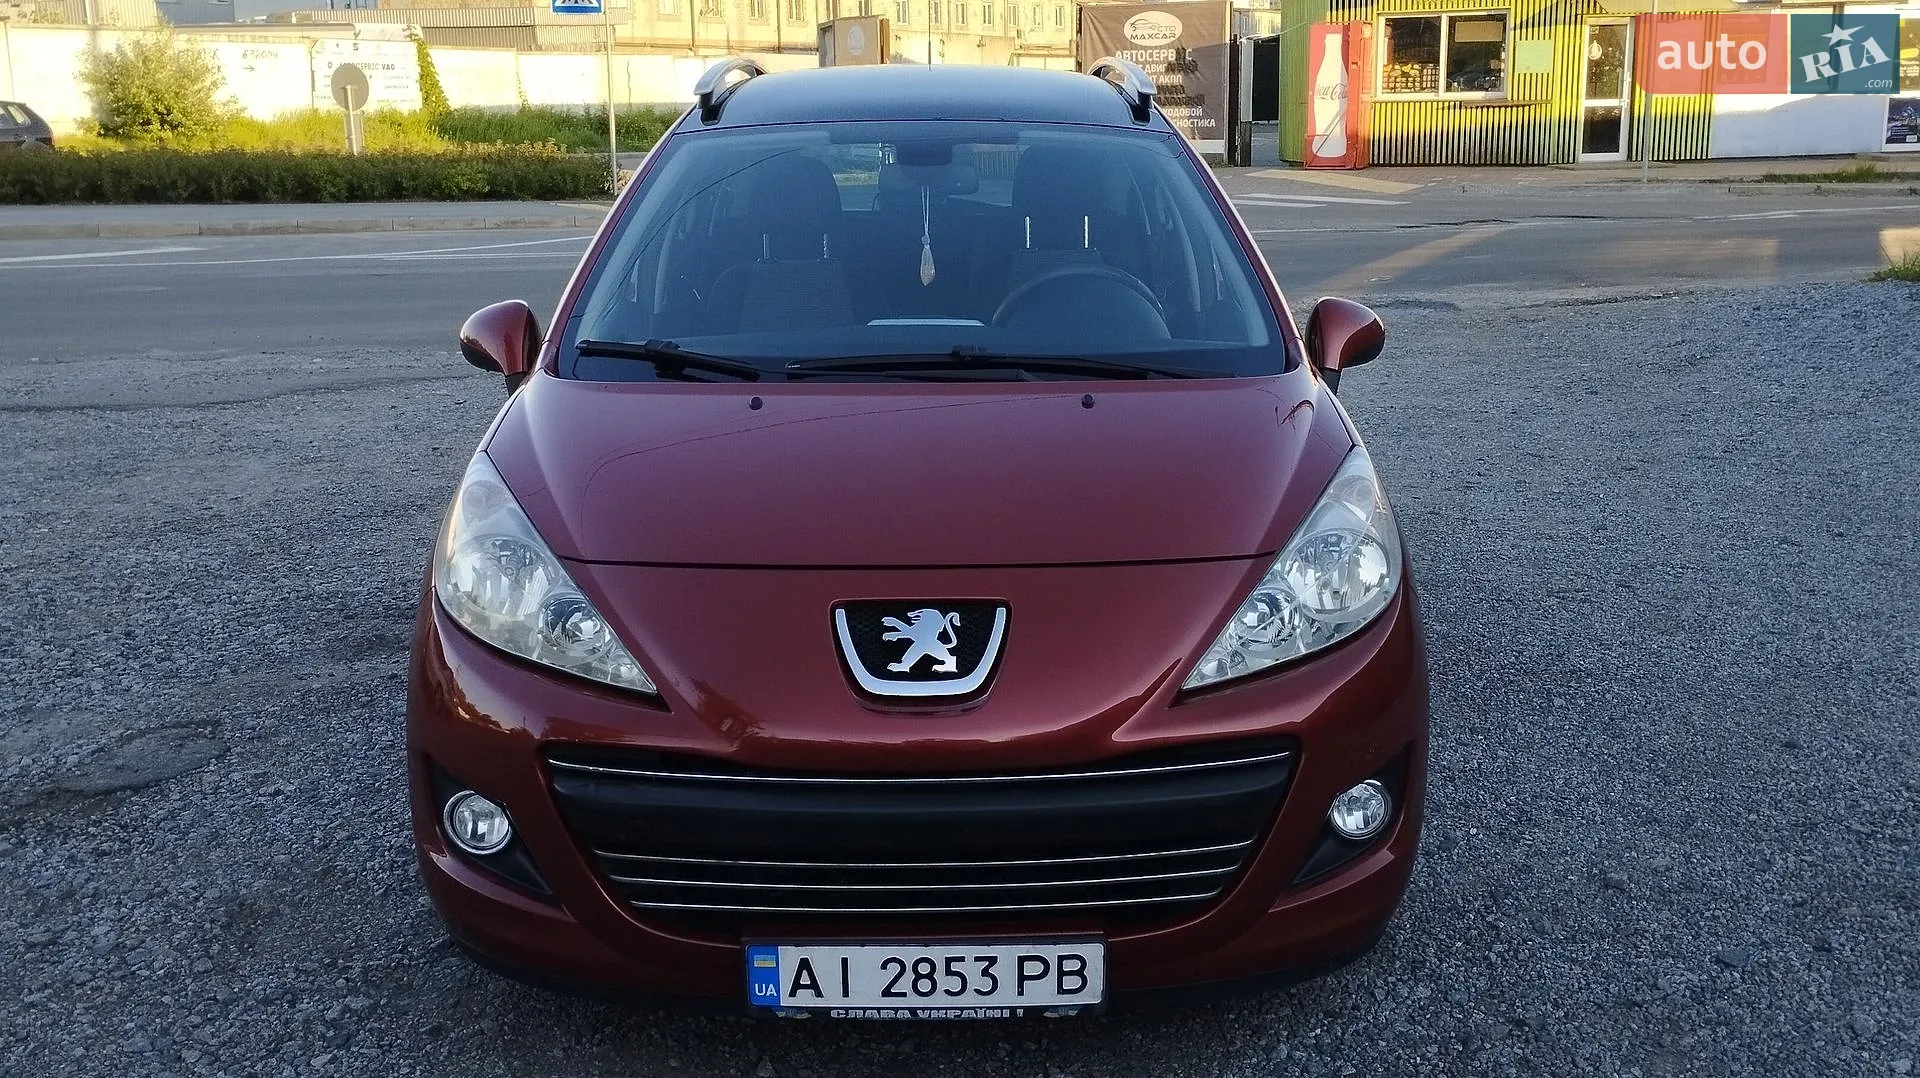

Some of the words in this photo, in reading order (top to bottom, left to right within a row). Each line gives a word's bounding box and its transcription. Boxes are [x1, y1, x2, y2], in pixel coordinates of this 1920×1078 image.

[1129, 32, 1177, 41] MAXCAR
[1115, 48, 1193, 62] АВТОСЕРВС
[788, 956, 851, 999] AI
[879, 955, 1000, 999] 2853
[1016, 953, 1089, 997] PB
[754, 983, 777, 997] UA
[830, 1009, 912, 1019] СЛАВА
